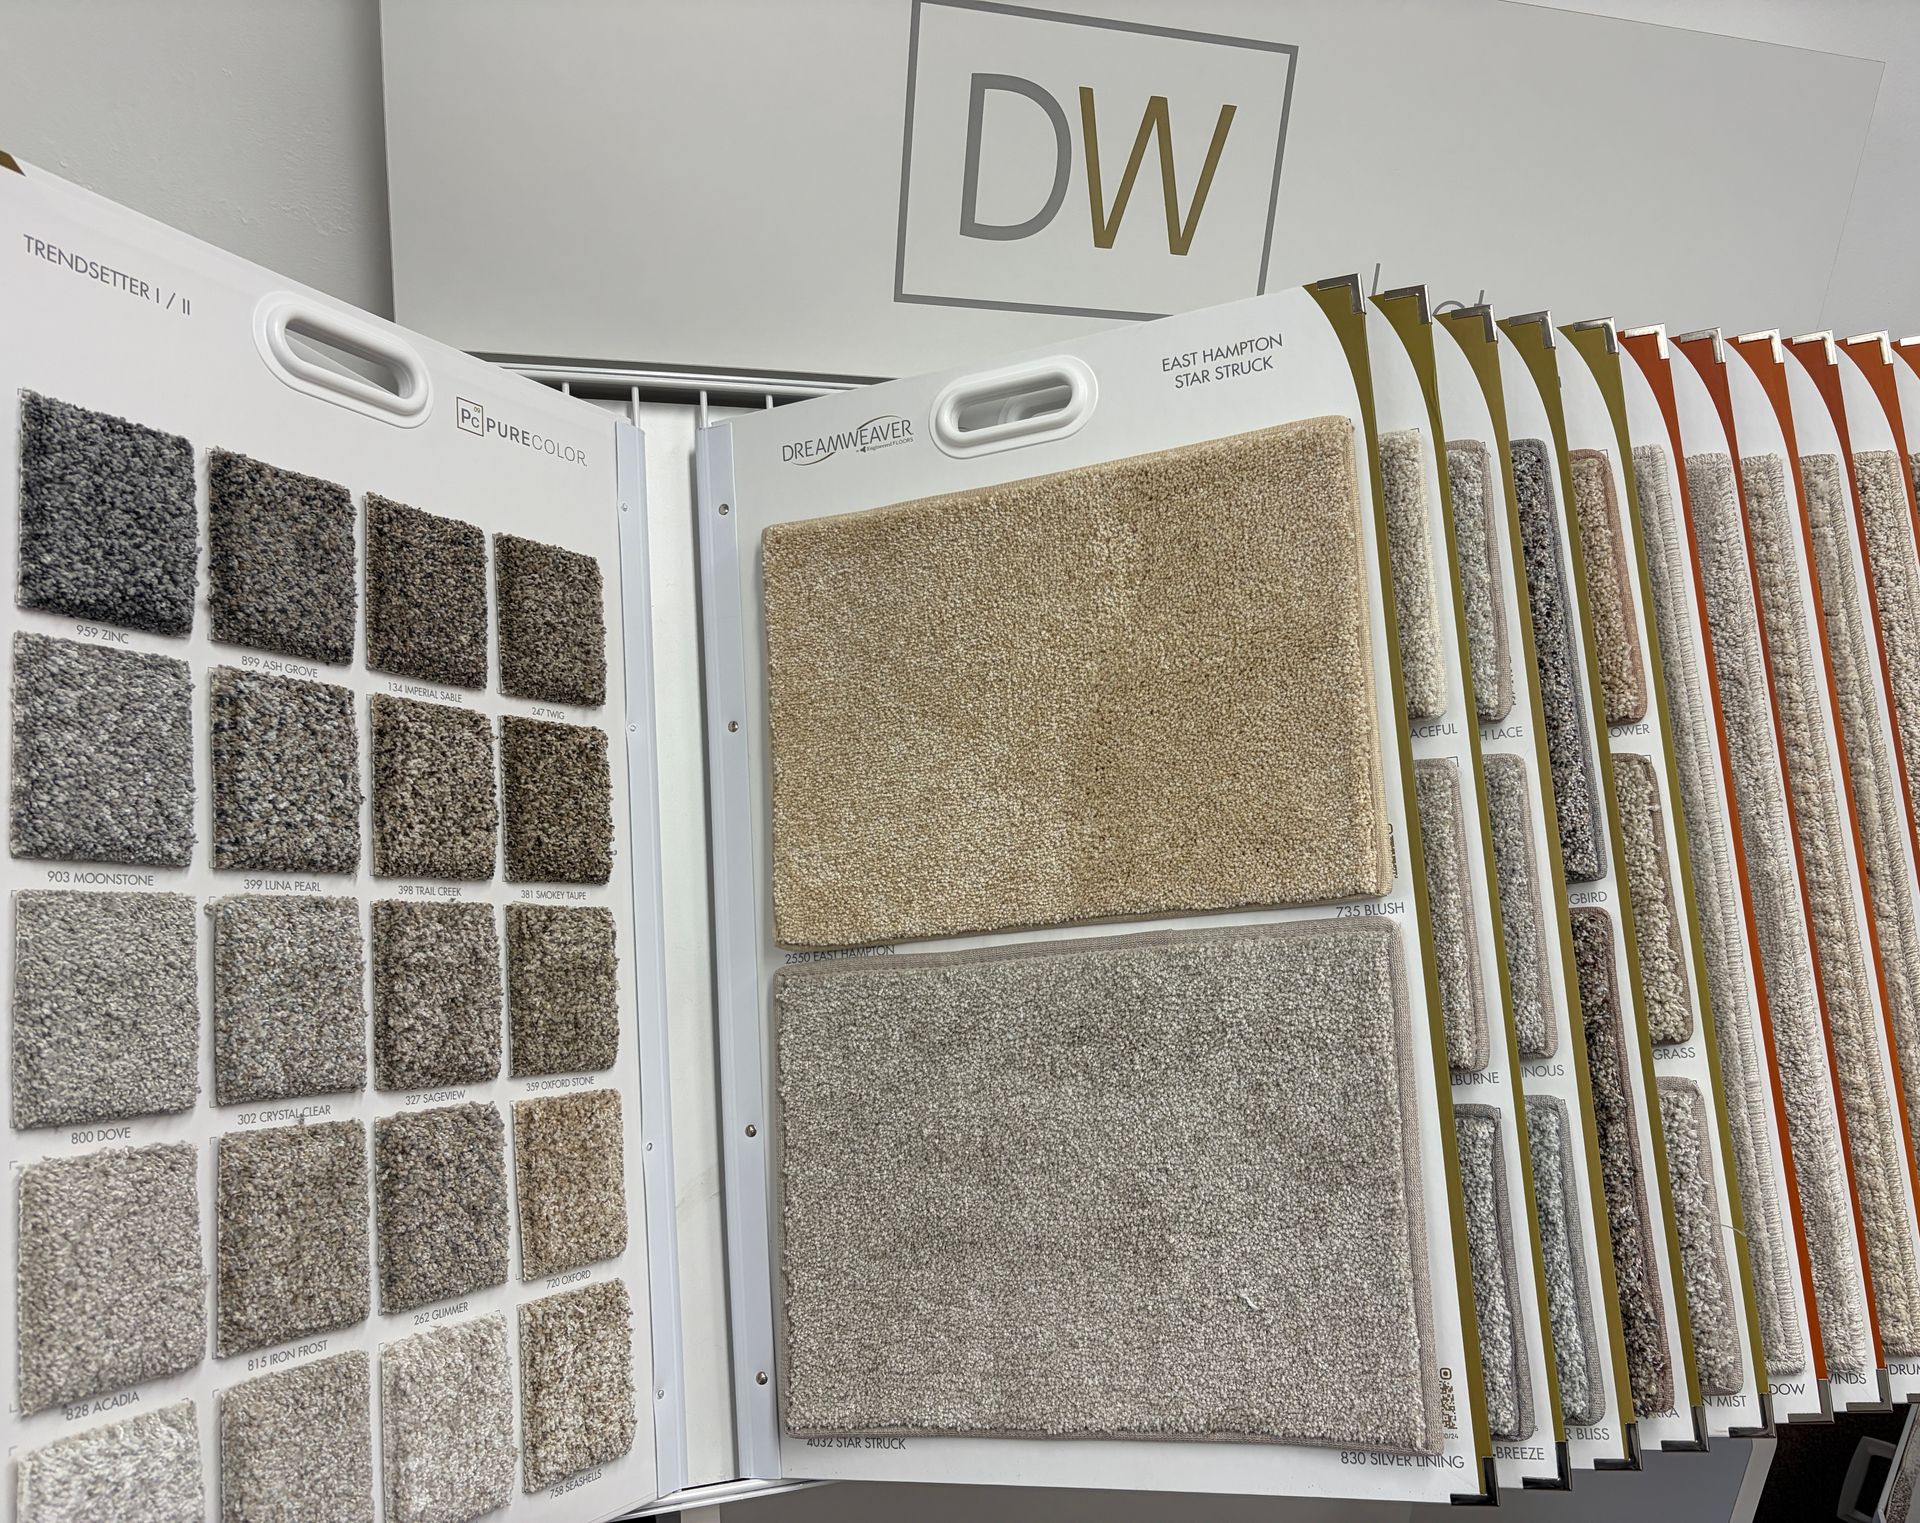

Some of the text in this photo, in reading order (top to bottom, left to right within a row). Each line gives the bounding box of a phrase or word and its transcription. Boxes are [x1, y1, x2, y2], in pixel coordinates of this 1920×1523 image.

[960, 73, 1237, 256] DW
[23, 234, 150, 300] TRENDSETTER
[1162, 333, 1283, 372] EAST HAMPTON
[1175, 355, 1274, 389] STAR STRUCK
[486, 417, 587, 467] PURECOLOR
[782, 419, 913, 462] DREAMWEAVER
[76, 625, 129, 645] 959 ZINC
[241, 656, 318, 679] 899 ASH GROVE
[388, 682, 463, 704] 134 IMPERIAL SABLE
[532, 707, 565, 720] 247 TWIG
[1492, 726, 1524, 741] LACE
[1608, 724, 1650, 738] OWER
[47, 871, 154, 887] 903 MOONSTONE
[243, 879, 322, 893] 399 LUNA PEARL
[398, 886, 462, 897] 398 TRAIL CREEK
[521, 889, 587, 900] 381 SMOKEY TAUPE
[1567, 891, 1608, 905] GBIRD
[1336, 902, 1405, 918] 735 BLUSH
[785, 945, 895, 965] 2550 EAST HAMPTON
[1652, 1047, 1696, 1060] GRASS
[526, 1075, 595, 1092] 359 OXFORD STONE
[405, 1090, 466, 1106] 327 SAGEVIEW
[238, 1104, 332, 1126] 302 CRYSTAL CLEAR
[71, 1127, 132, 1145] 800 DOVE
[546, 1269, 592, 1290] 720 OXFORD
[414, 1301, 469, 1326] 262 GLIMMER
[248, 1340, 328, 1372] 815 IRON FROST
[1886, 1363, 1920, 1376] DRU
[66, 1391, 140, 1421] 828 ACADIA
[1717, 1395, 1747, 1408] MIST
[1576, 1427, 1610, 1441] BLISS
[806, 1437, 906, 1450] 4032 STAR STRUCK
[1341, 1451, 1465, 1469] 830 SILVER LINING
[1495, 1446, 1545, 1461] BREEZE
[550, 1468, 602, 1499] 758 SEASHELLS
